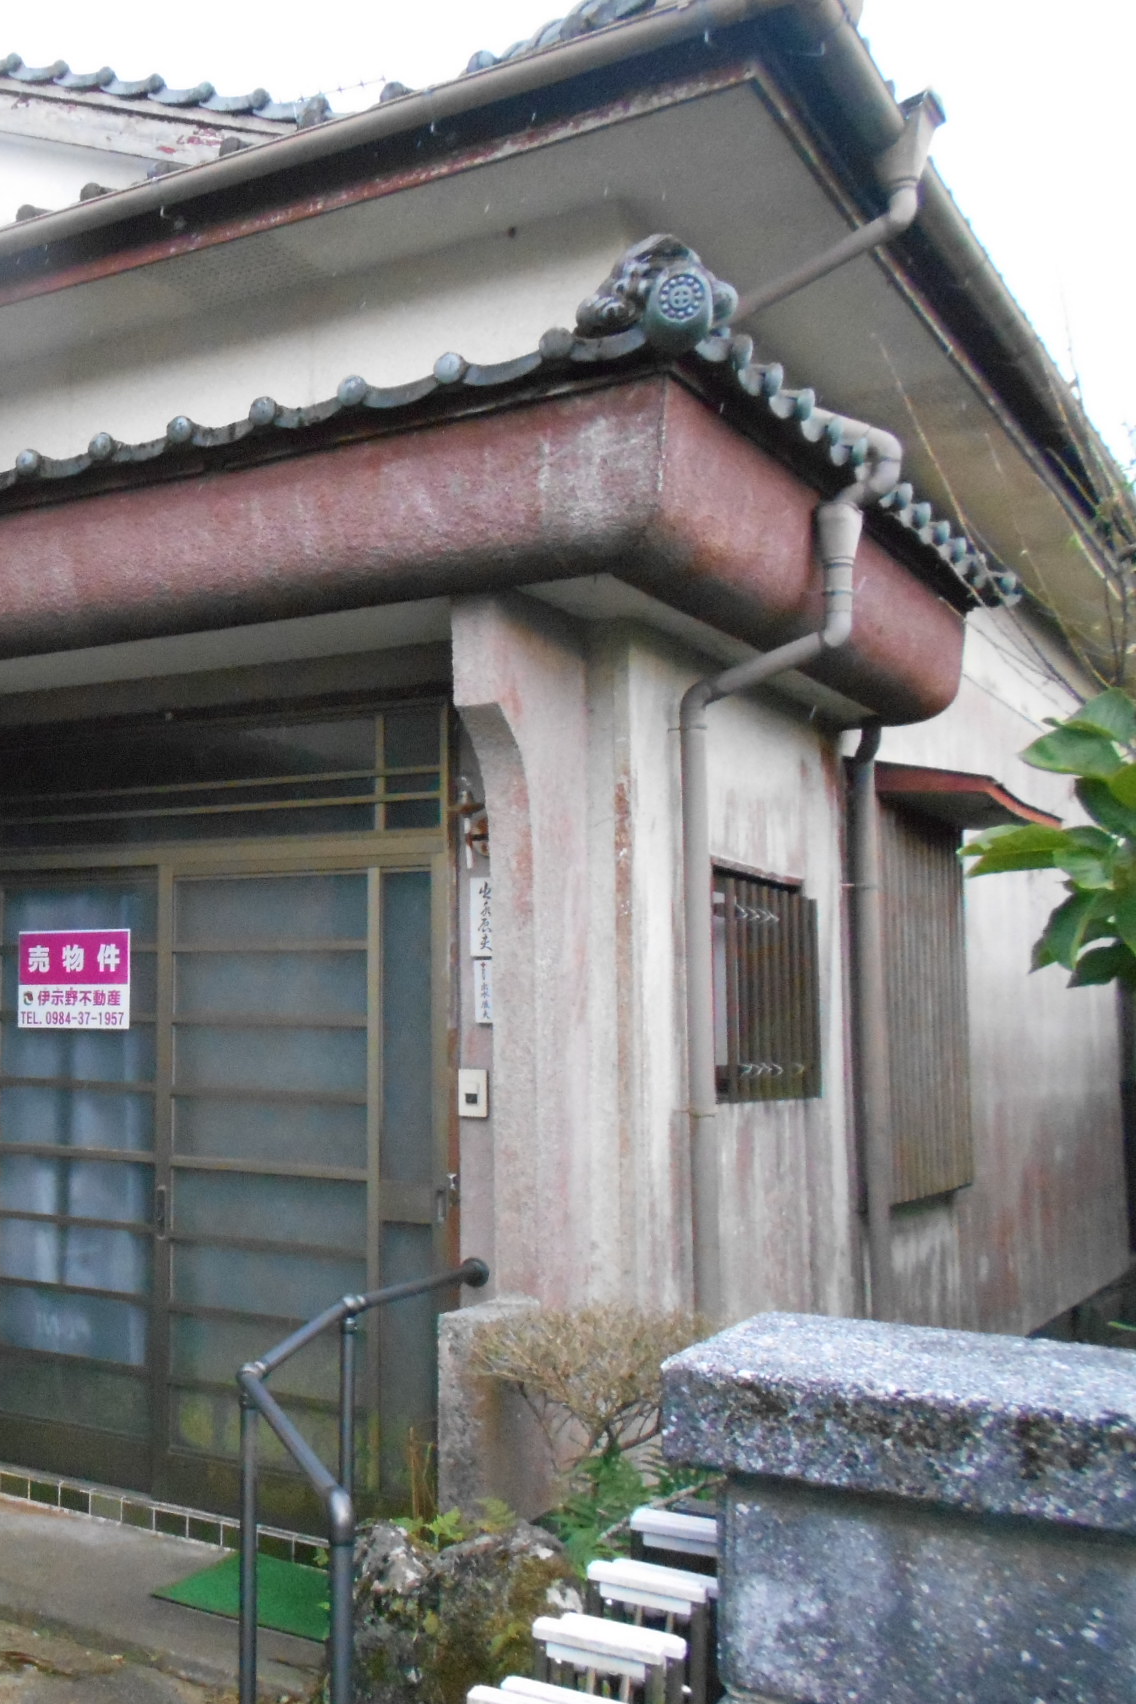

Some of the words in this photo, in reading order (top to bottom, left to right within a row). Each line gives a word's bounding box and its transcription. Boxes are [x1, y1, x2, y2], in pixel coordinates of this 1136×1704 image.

[28, 943, 120, 973] 売物件
[38, 990, 121, 1006] 伊示野不動産
